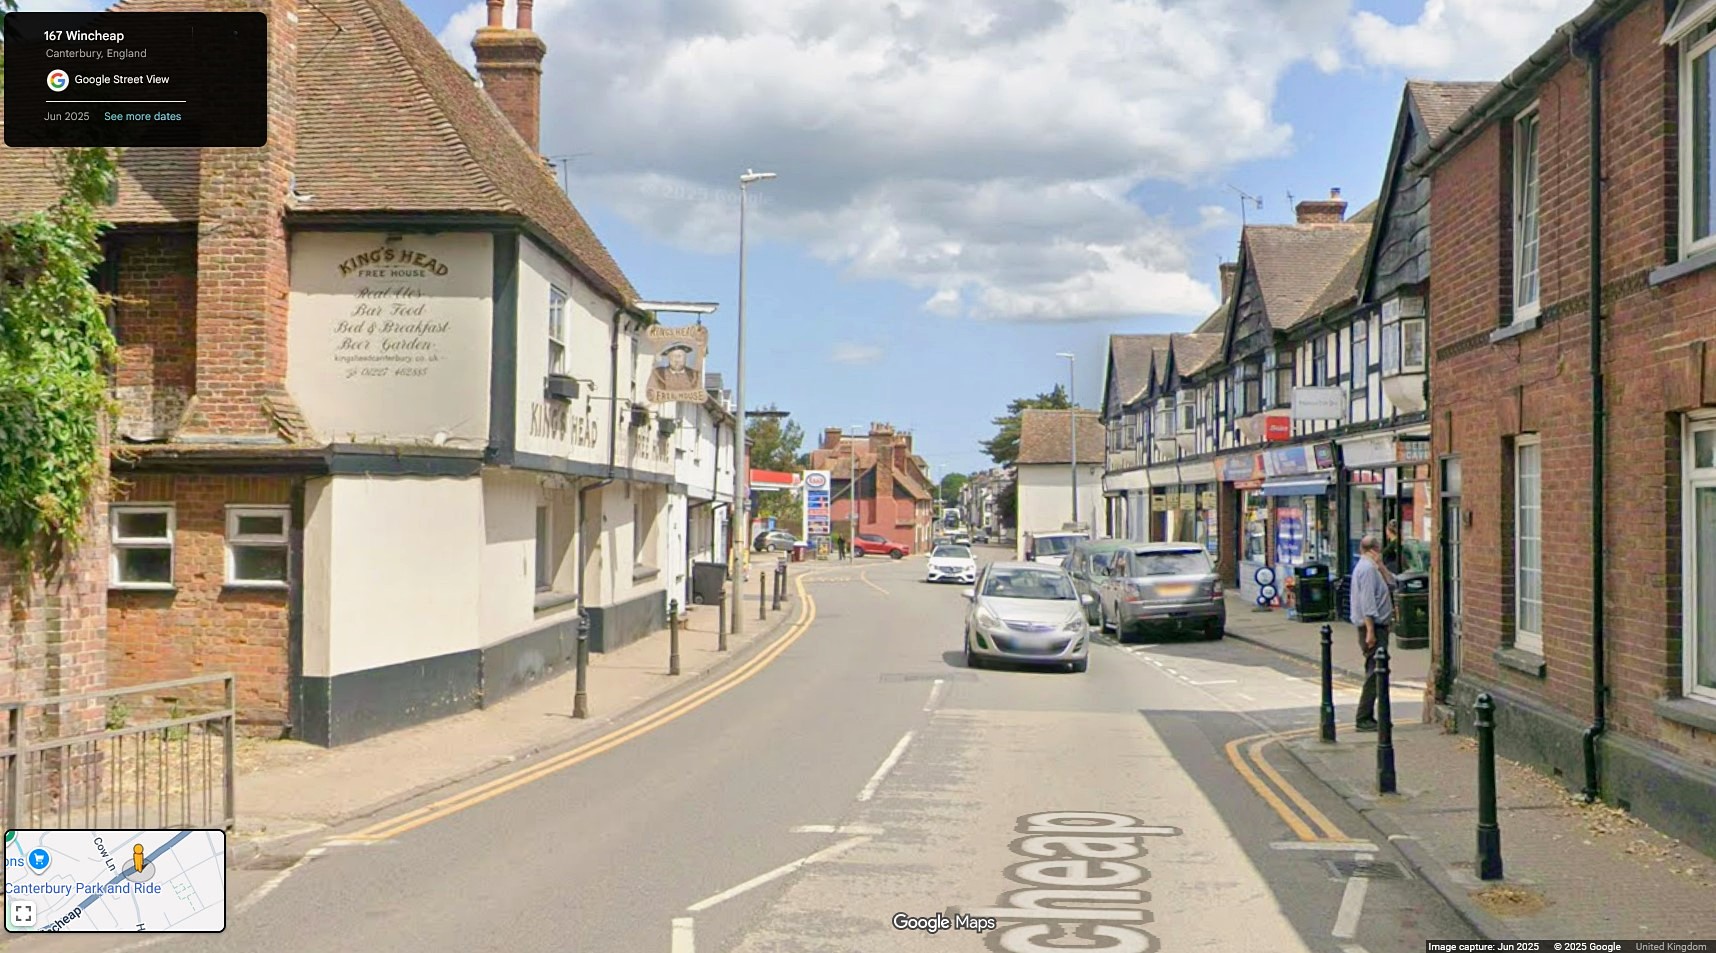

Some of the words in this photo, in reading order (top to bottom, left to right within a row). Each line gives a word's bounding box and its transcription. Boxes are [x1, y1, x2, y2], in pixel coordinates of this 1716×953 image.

[339, 247, 395, 276] KING'S
[400, 250, 449, 277] HEAD
[351, 303, 383, 316] Bar
[390, 303, 427, 316] Food
[335, 320, 363, 334] Bed
[336, 337, 371, 350] Beer
